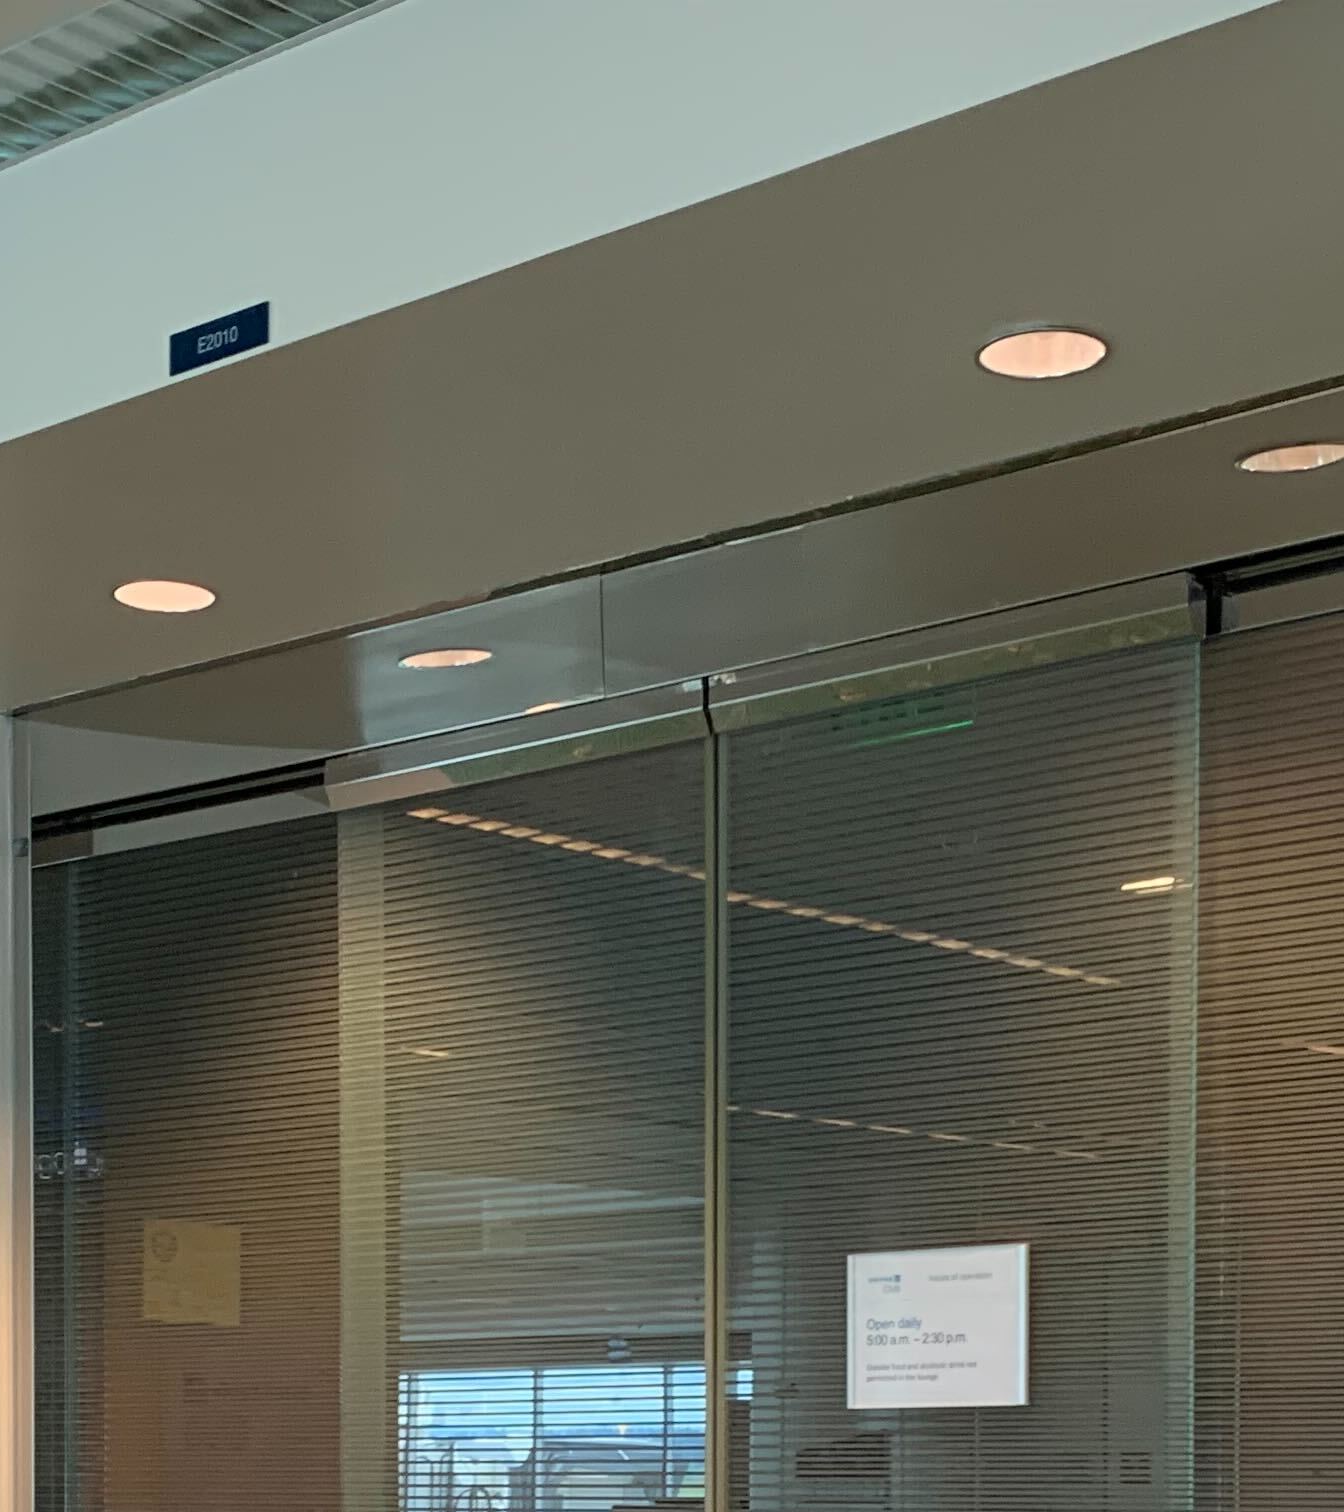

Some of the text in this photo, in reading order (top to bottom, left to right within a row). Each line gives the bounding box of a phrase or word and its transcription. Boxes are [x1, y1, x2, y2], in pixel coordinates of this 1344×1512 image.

[197, 326, 239, 354] E2010
[866, 1317, 922, 1331] Open daily
